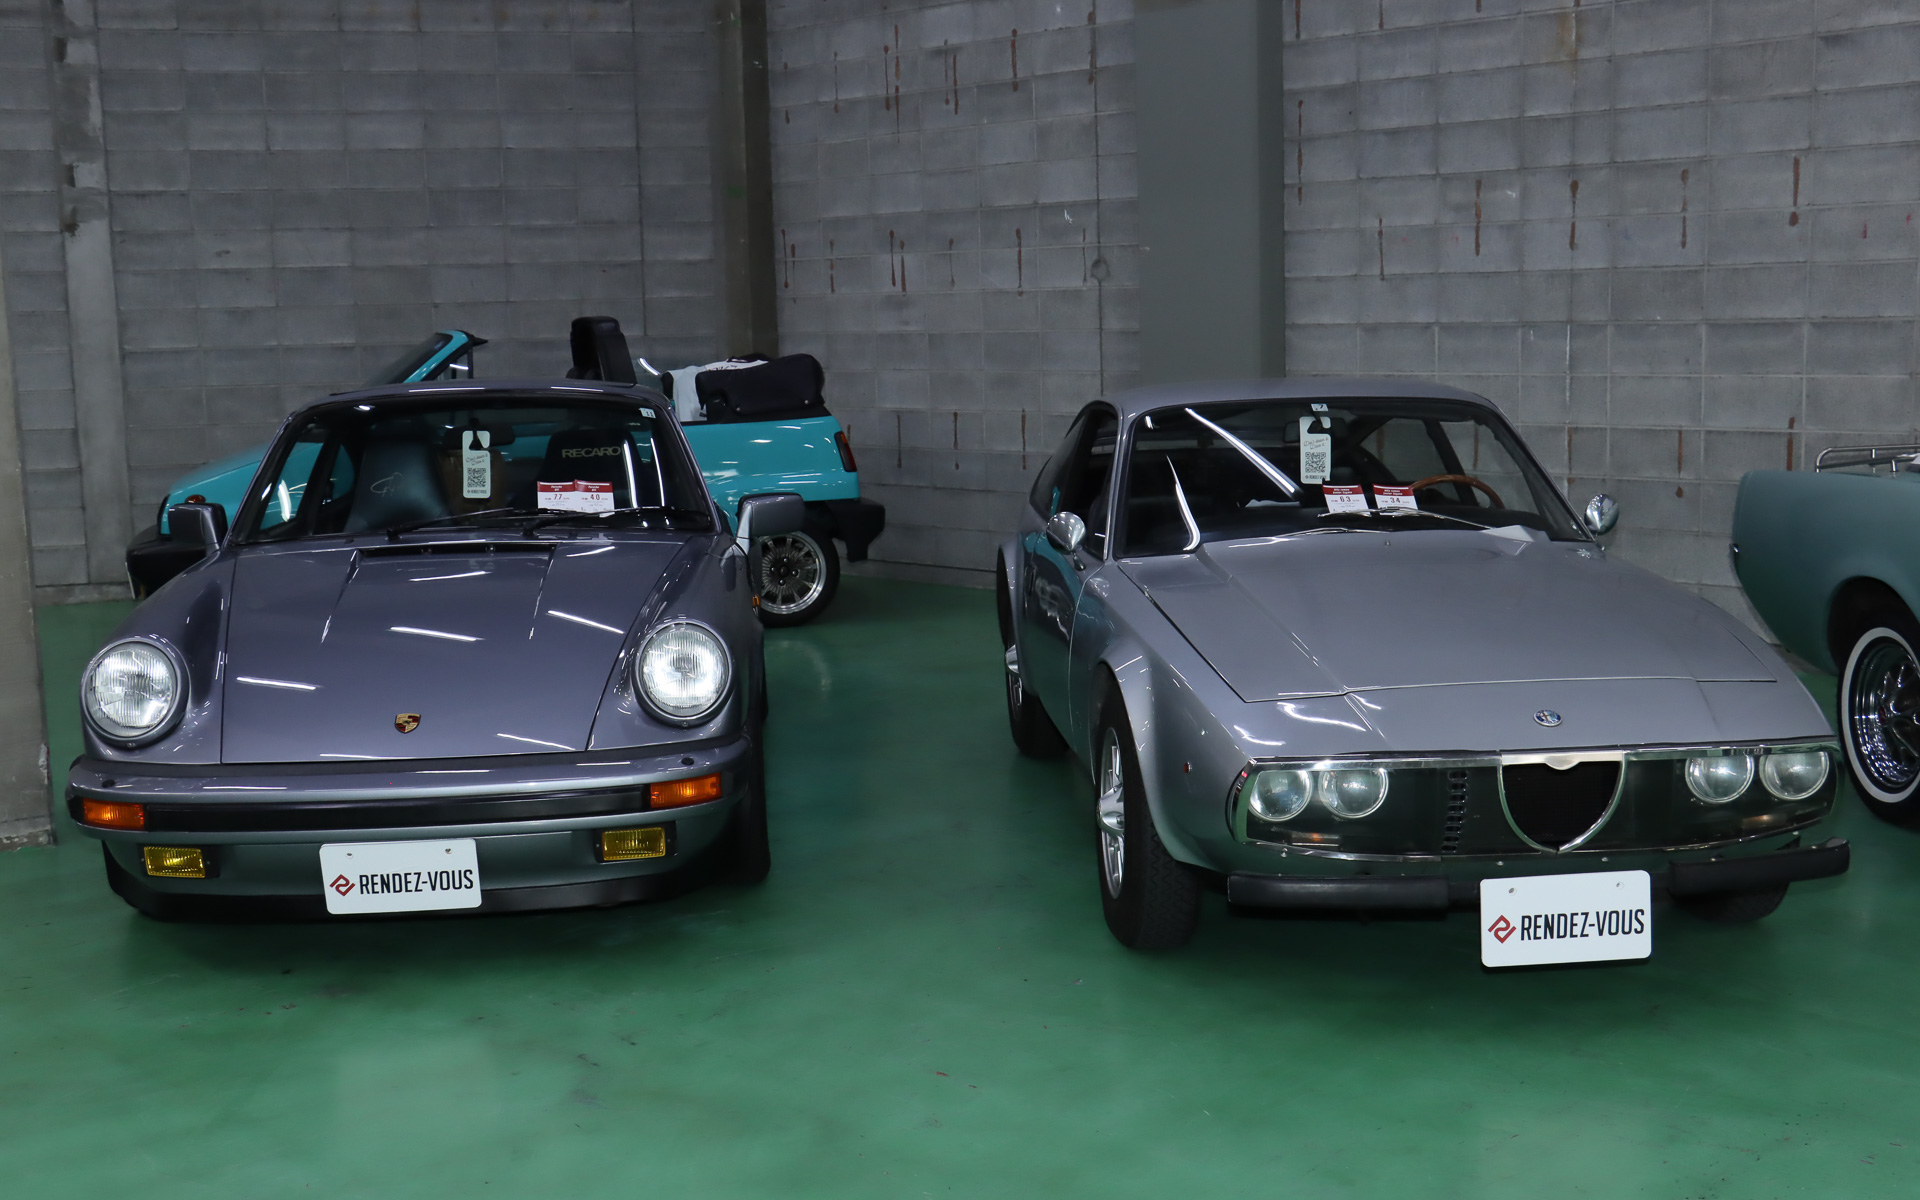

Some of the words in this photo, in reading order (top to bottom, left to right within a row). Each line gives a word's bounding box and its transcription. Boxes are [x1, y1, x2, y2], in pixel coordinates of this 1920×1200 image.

[561, 446, 622, 458] RECARO
[359, 869, 474, 895] RENDEZ-VOUS
[1520, 908, 1645, 941] RENDEZ-VOUS
